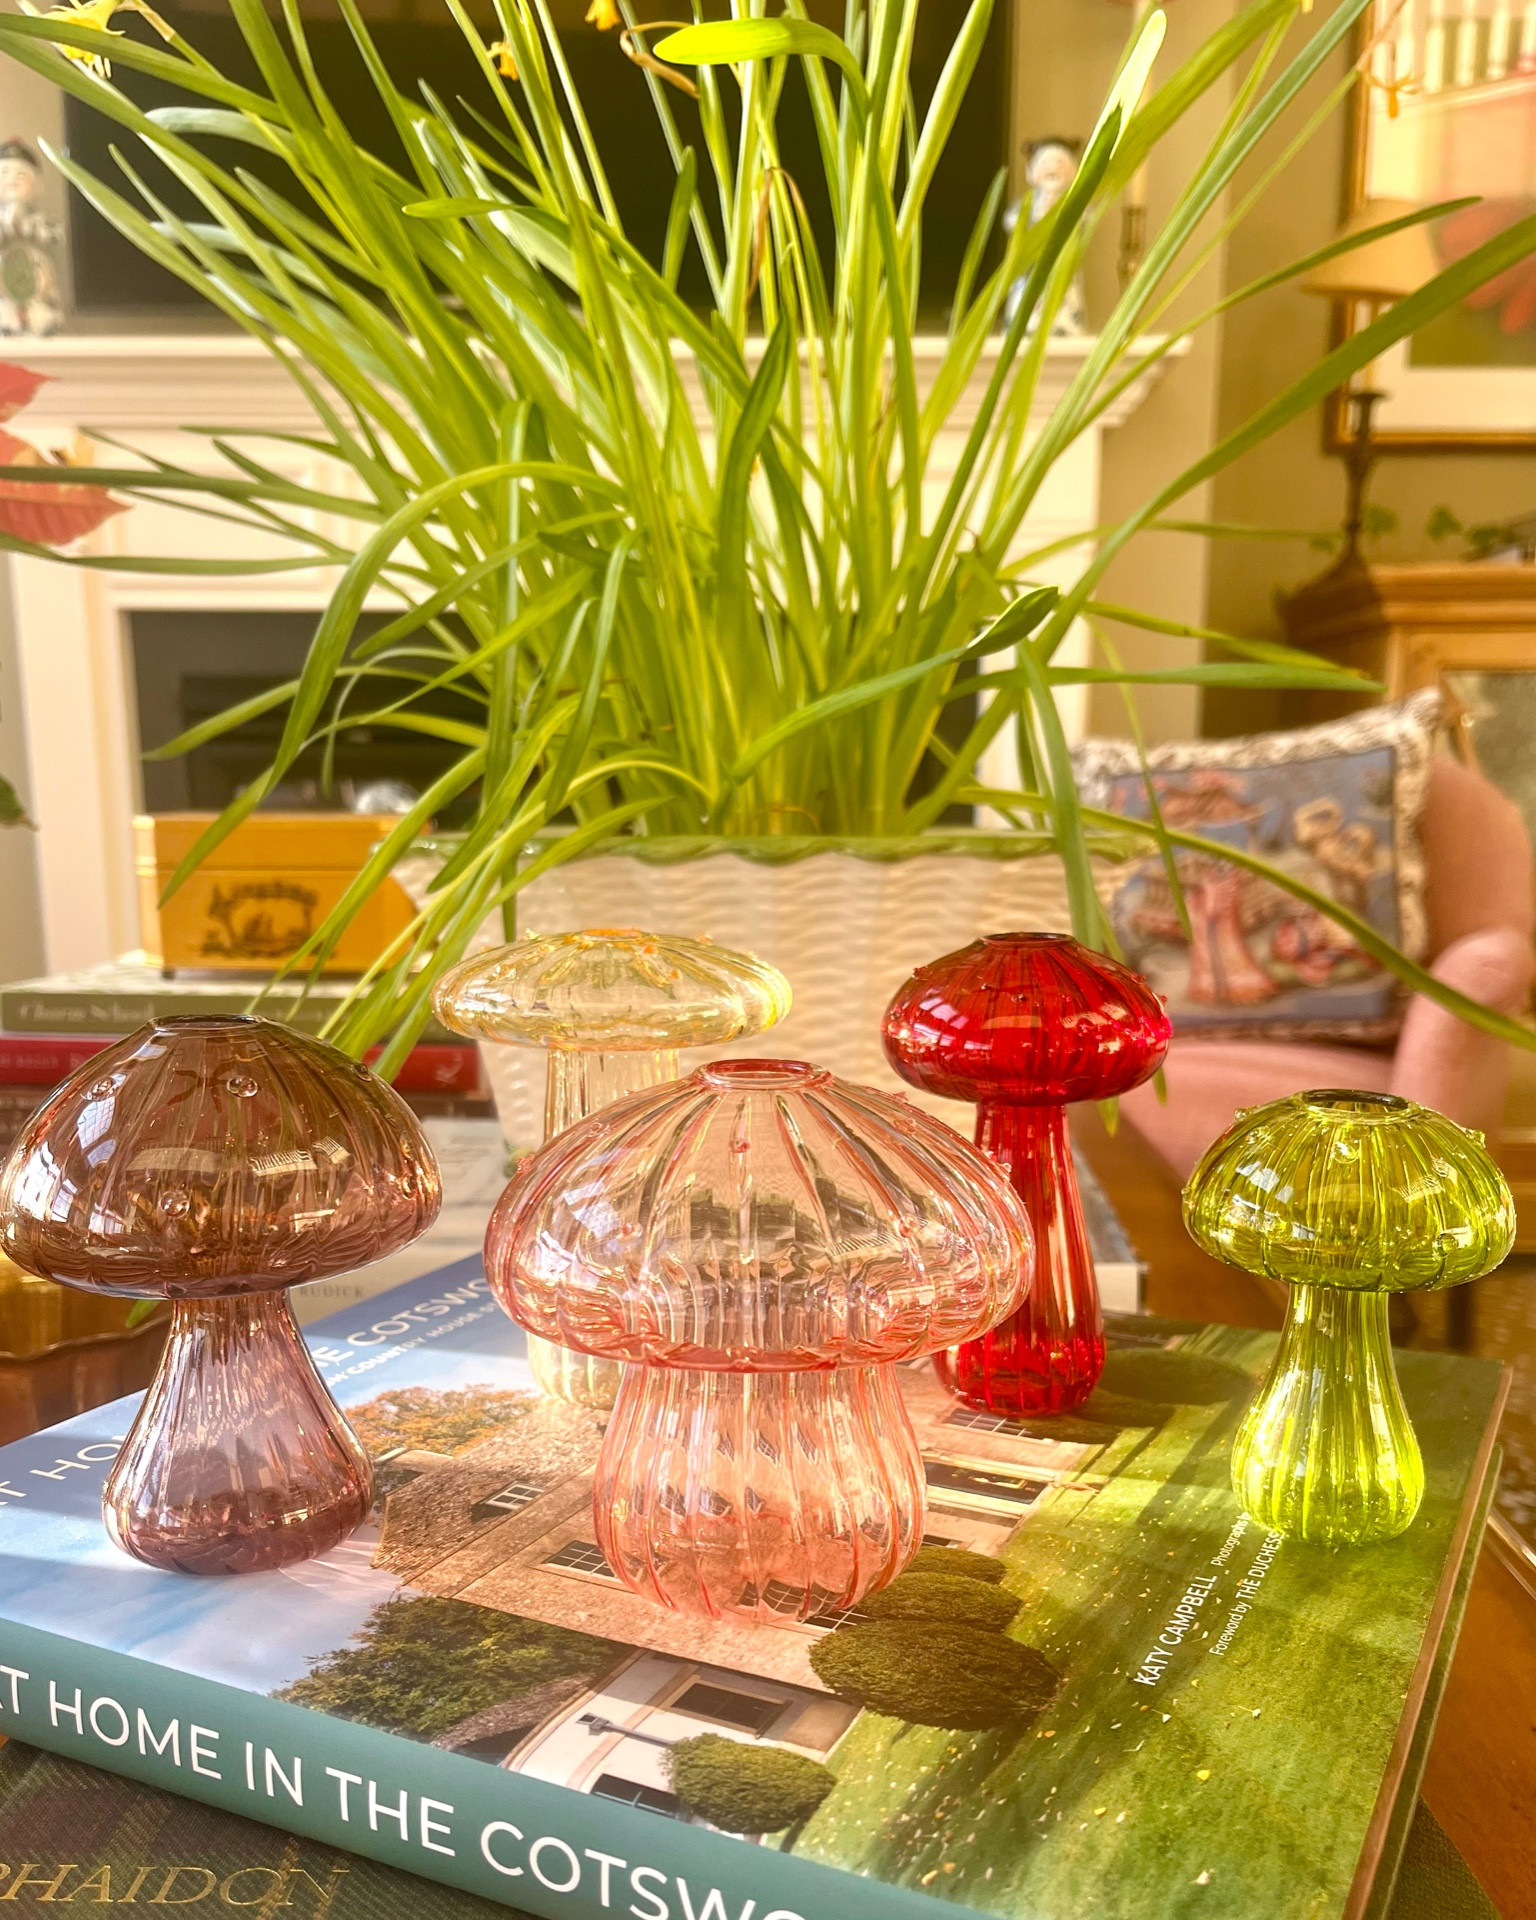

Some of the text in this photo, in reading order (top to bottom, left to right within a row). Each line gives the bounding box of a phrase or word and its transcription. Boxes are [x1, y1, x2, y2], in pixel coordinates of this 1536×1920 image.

[0, 1480, 27, 1506] T
[29, 1435, 128, 1481] HO
[1133, 1645, 1174, 1687] KATY
[1158, 1575, 1219, 1646] CAMPBELL
[1210, 1519, 1249, 1567] Photographs
[1233, 1600, 1254, 1614] by
[1235, 1578, 1261, 1600] THE
[1208, 1612, 1244, 1656] Foreword
[0, 1665, 807, 1920] T HOME IN THE COTSW
